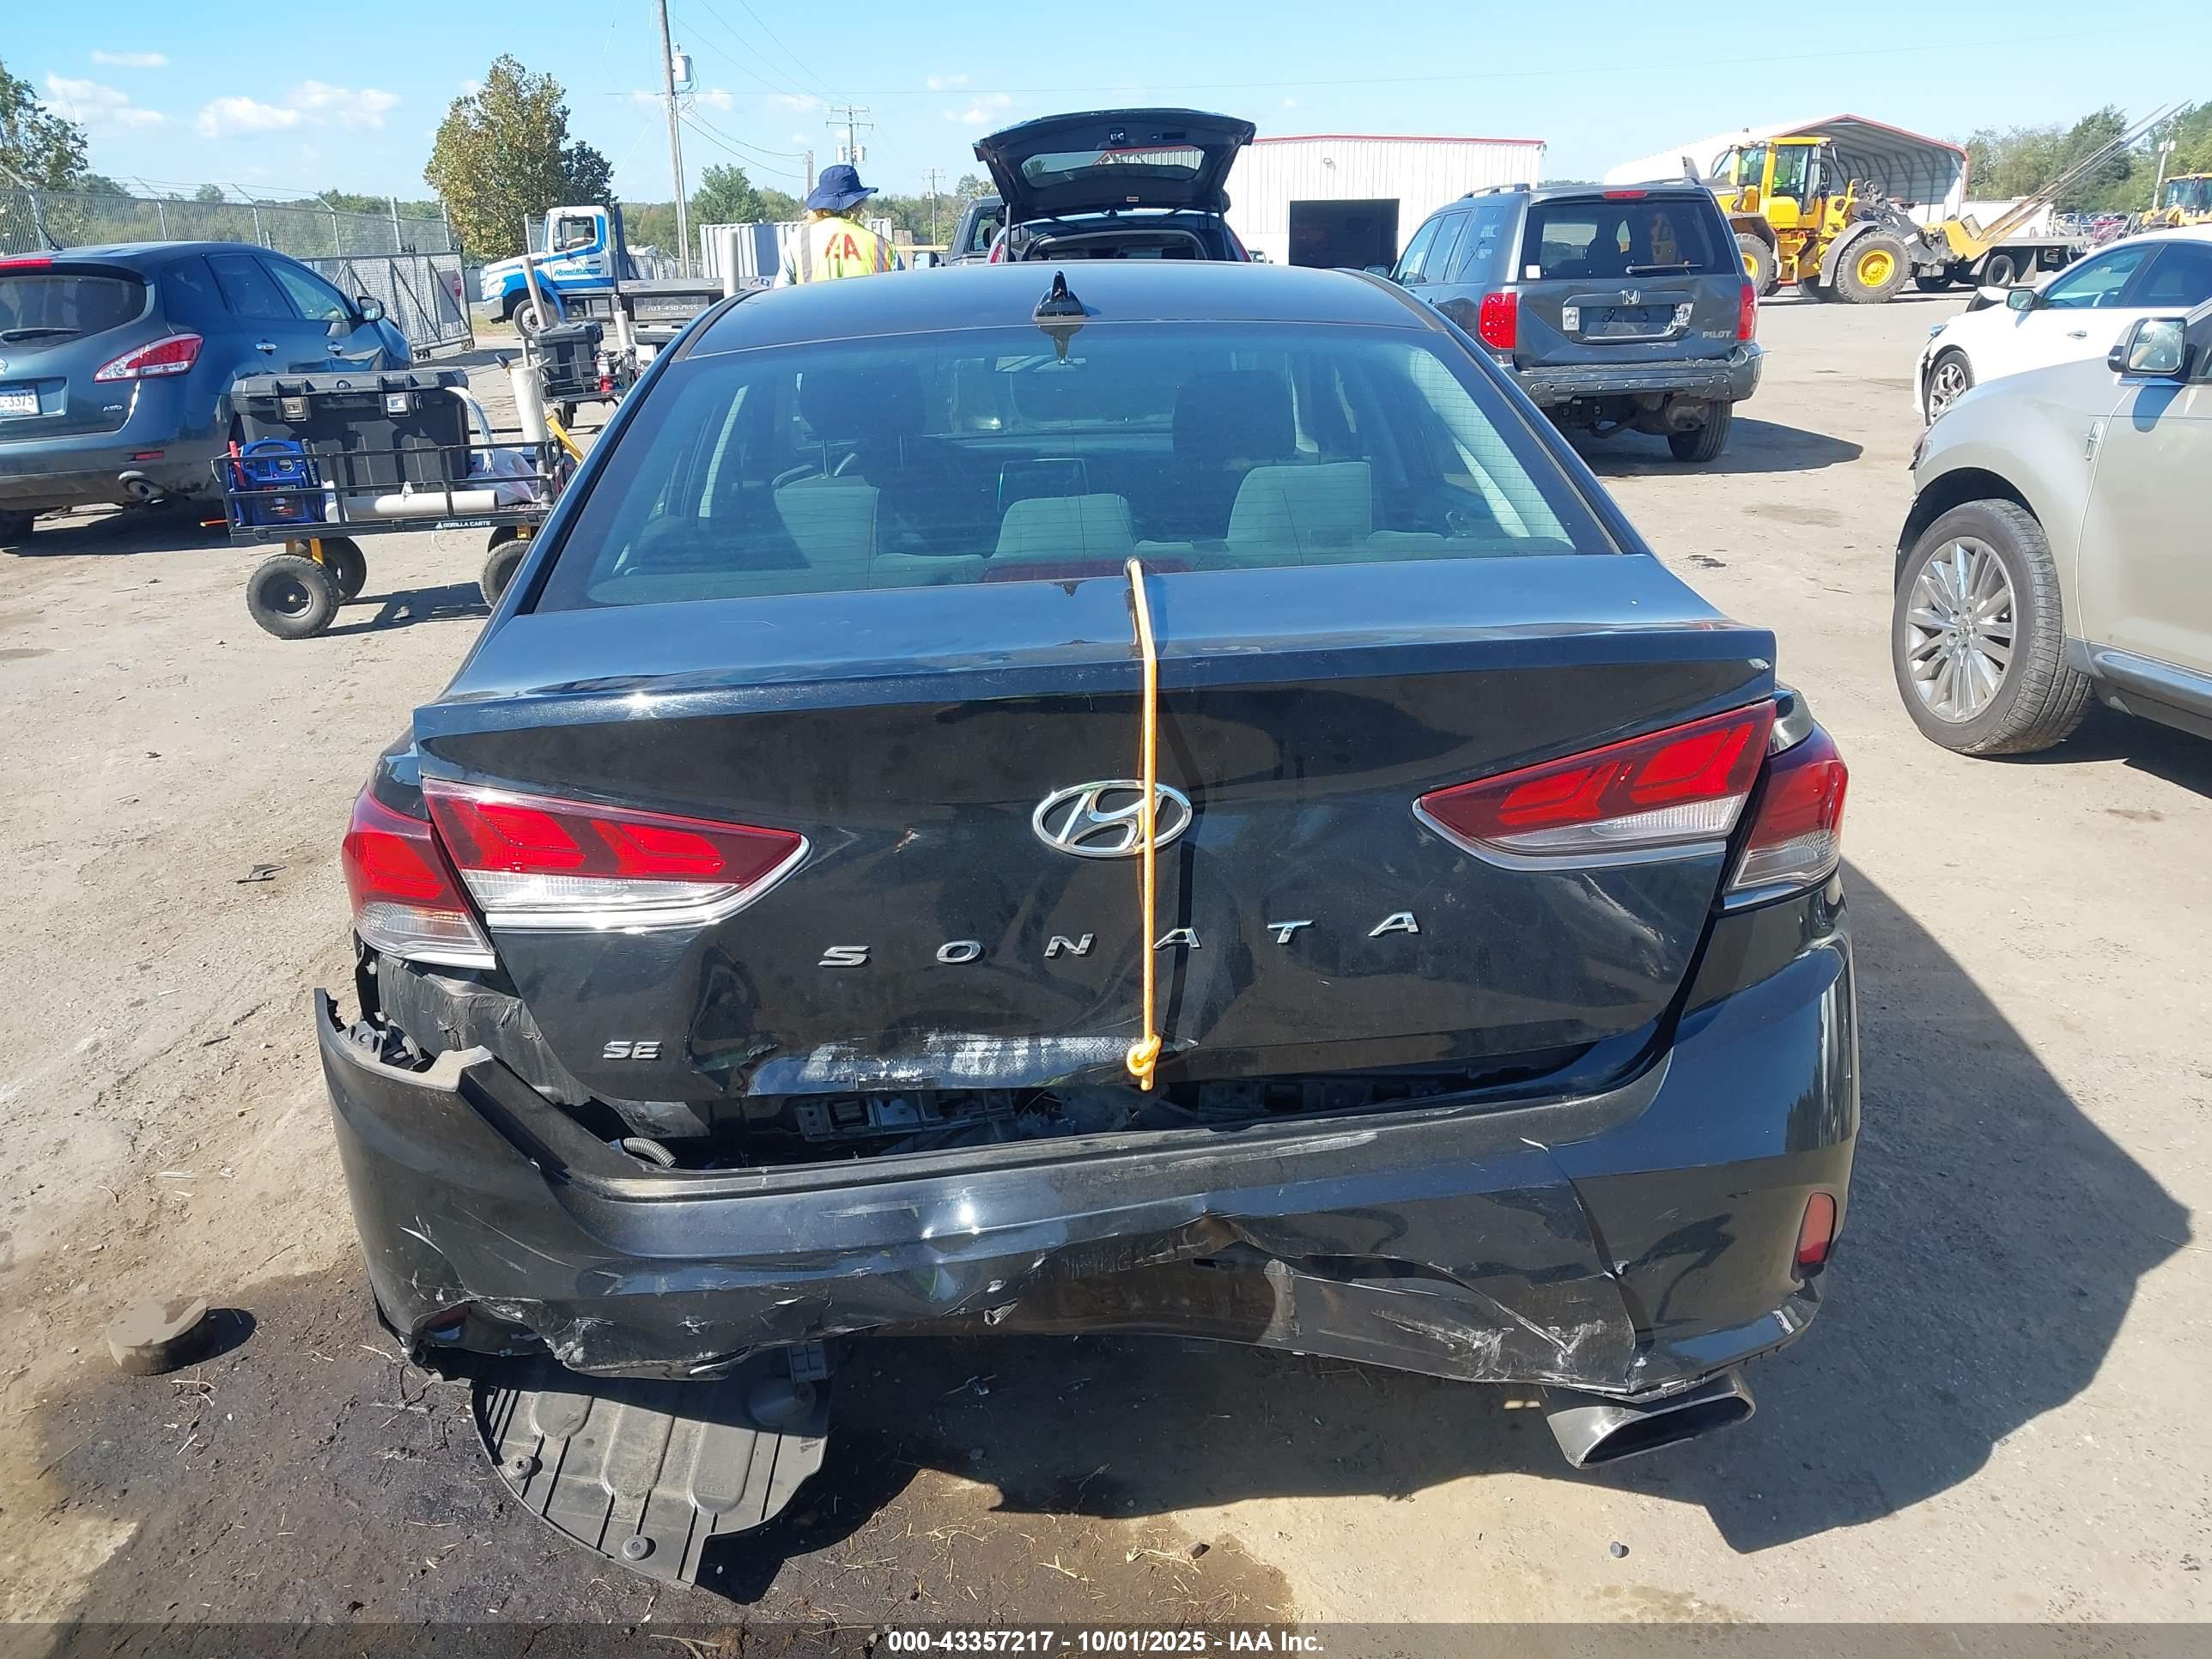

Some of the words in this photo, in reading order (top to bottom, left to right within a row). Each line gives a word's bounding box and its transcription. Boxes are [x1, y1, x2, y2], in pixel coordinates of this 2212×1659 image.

[1702, 330, 1732, 338] PILOT
[817, 911, 1422, 968] SONATA
[602, 1041, 662, 1060] SE
